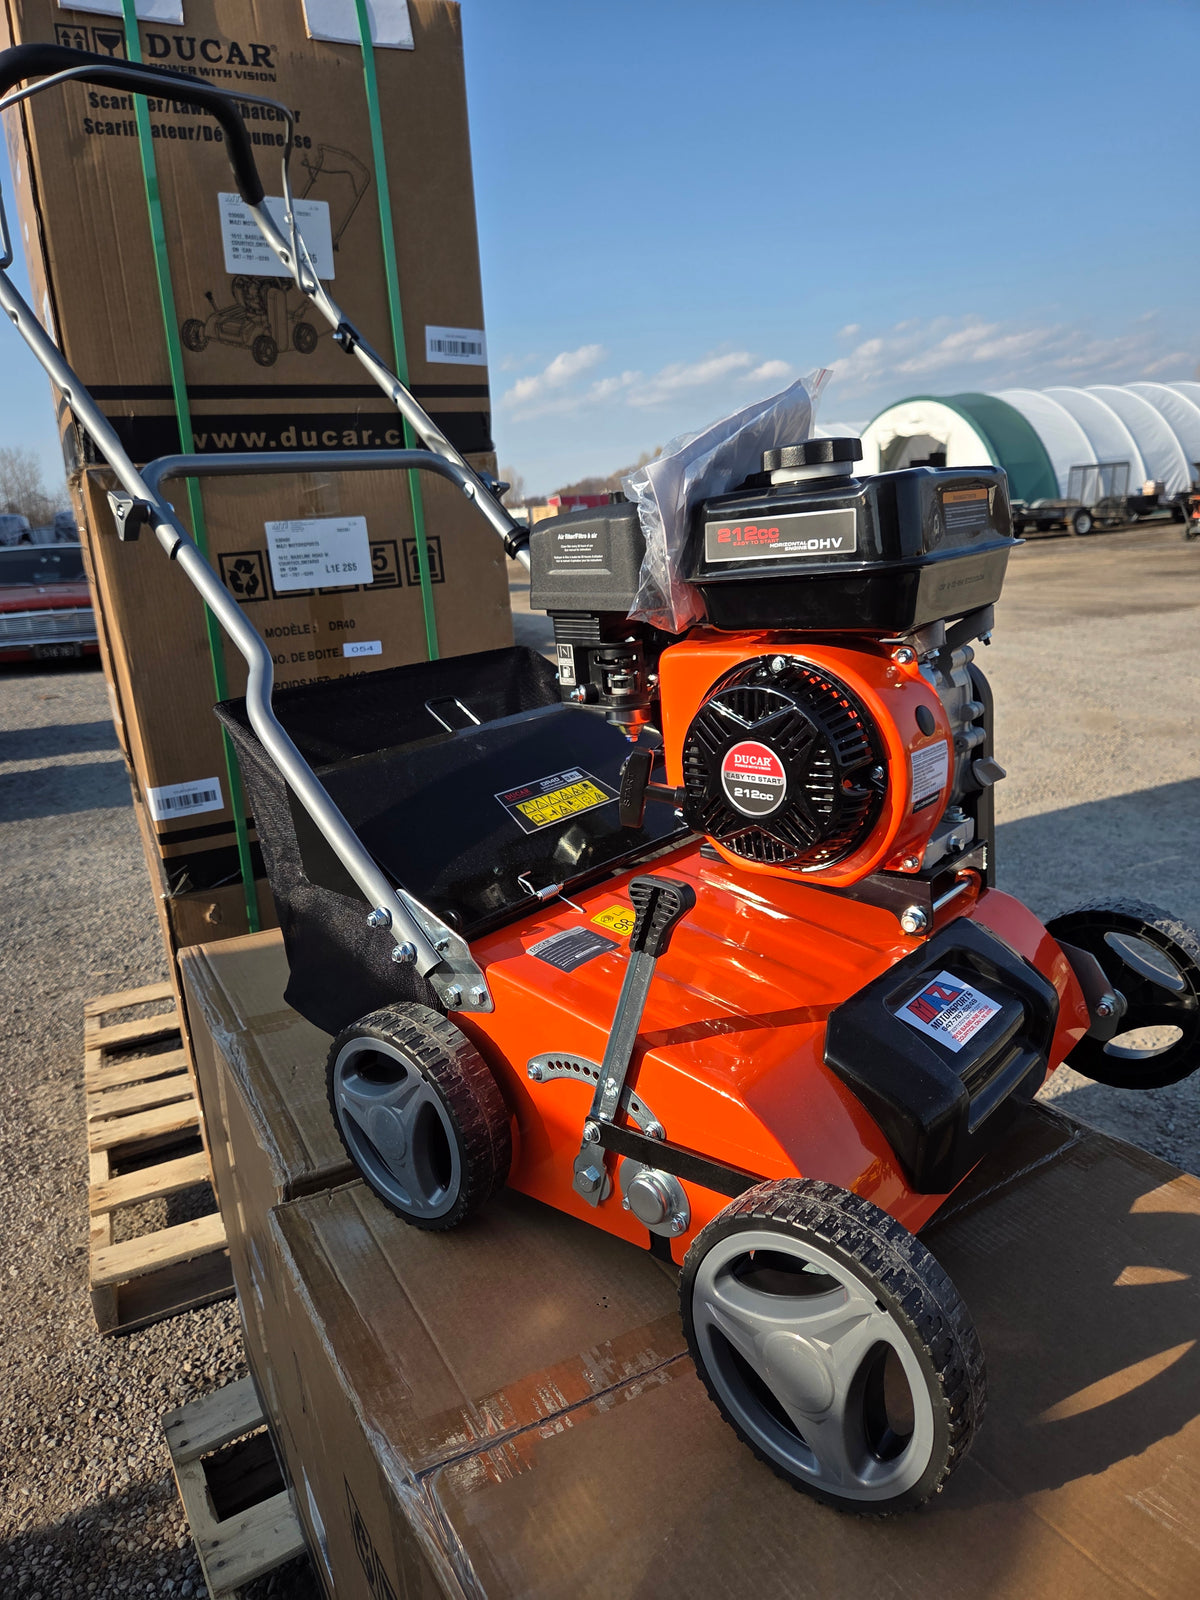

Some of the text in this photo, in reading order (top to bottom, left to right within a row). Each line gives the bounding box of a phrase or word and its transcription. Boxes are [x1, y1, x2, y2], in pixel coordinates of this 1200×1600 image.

[145, 33, 275, 68] DUCAR
[199, 66, 233, 78] WITH
[234, 70, 277, 82] VISION
[717, 526, 780, 543] 212cc
[769, 537, 842, 550] HORIZONTAL OHV
[325, 564, 340, 574] L1E
[342, 562, 358, 572] 2S5
[328, 619, 356, 632] DR40
[291, 652, 306, 662] DE
[734, 754, 771, 766] DUCAR
[734, 788, 774, 801] 212cc
[929, 990, 974, 1030] MOTORSPORTS
